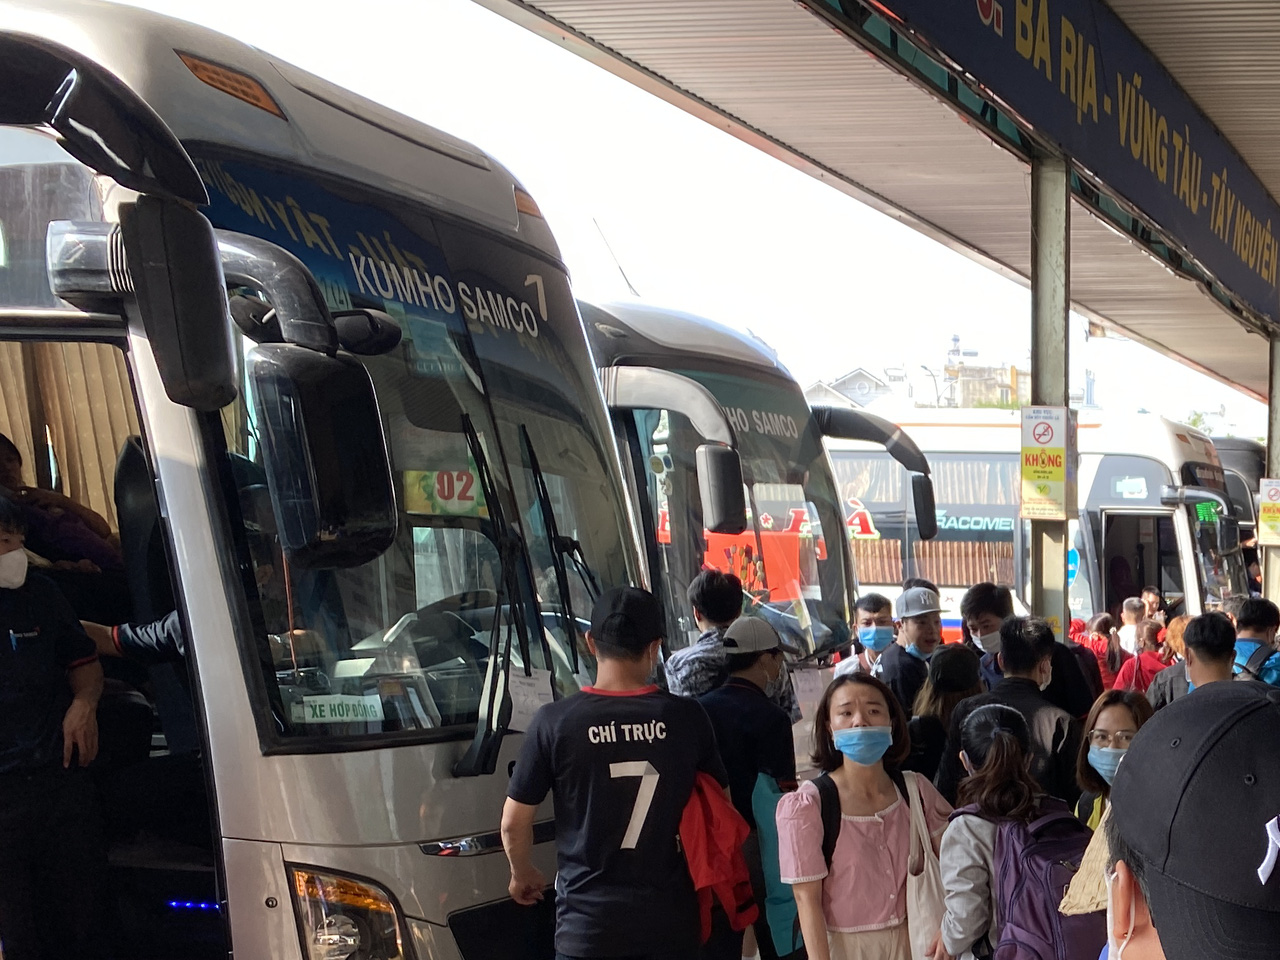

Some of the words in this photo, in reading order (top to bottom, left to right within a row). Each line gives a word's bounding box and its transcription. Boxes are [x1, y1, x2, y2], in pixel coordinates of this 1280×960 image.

[1060, 14, 1098, 125] RỊA
[1117, 71, 1168, 185] VŨNG
[1173, 123, 1202, 215] TÀU
[1210, 167, 1235, 245] TÂY
[1233, 199, 1279, 288] NGUYÊN
[348, 252, 456, 314] KUMHO
[456, 281, 539, 338] SAMCO
[751, 409, 798, 439] SAMCO
[437, 470, 475, 501] 02
[310, 703, 326, 718] XE
[588, 720, 617, 744] CHÍ
[621, 719, 667, 744] TRỰC
[609, 760, 660, 850] 7
